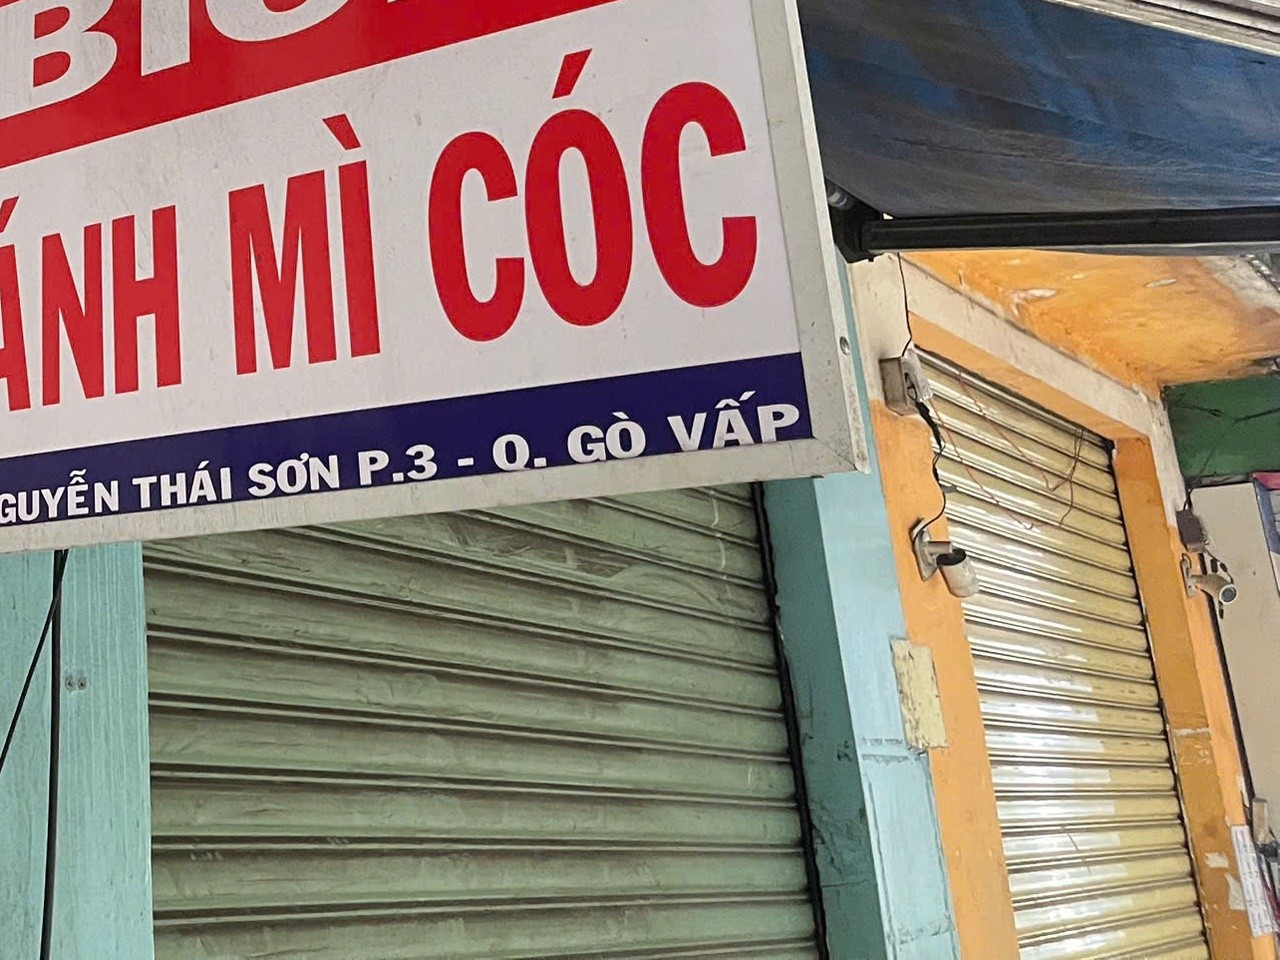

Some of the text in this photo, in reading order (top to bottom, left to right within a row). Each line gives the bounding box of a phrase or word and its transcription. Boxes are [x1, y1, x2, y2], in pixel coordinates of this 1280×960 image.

[229, 113, 382, 376] MÌ
[428, 48, 758, 343] CÓC
[132, 460, 232, 509] THÁI
[248, 452, 340, 498] SƠN
[357, 443, 438, 486] P.3
[456, 456, 475, 468] -
[567, 411, 646, 464] GÒ
[667, 390, 801, 453] VẤP
